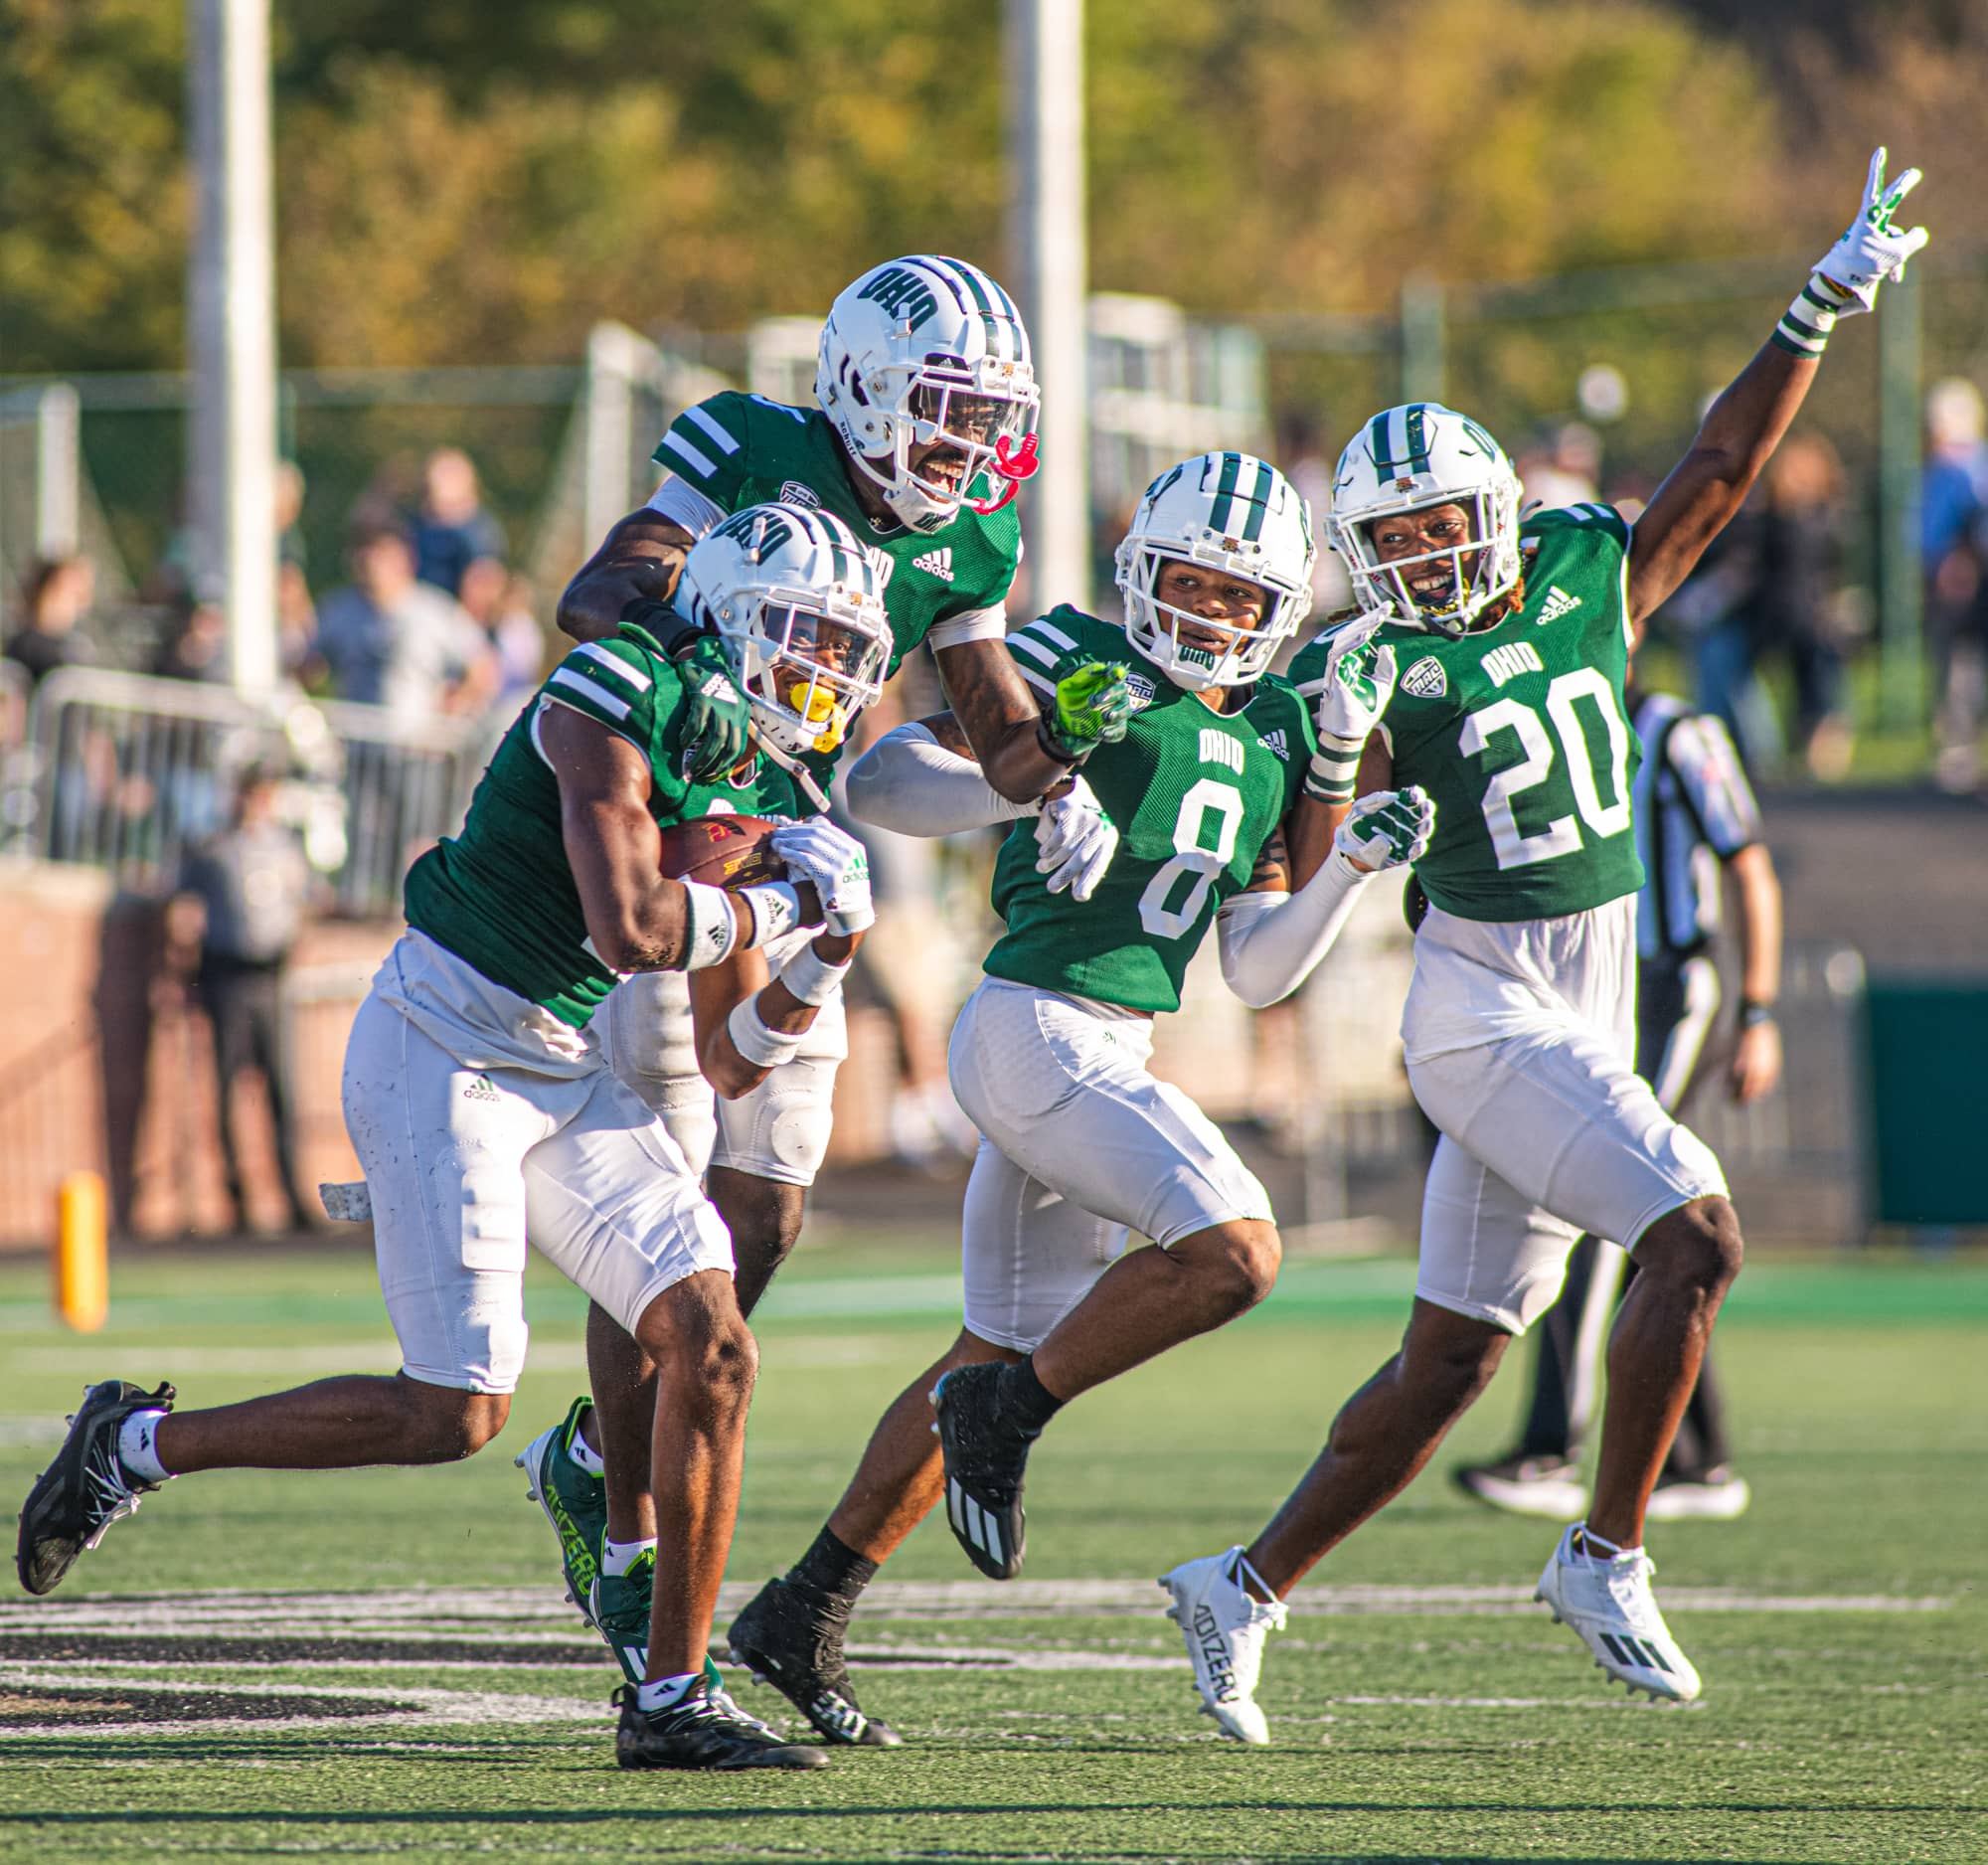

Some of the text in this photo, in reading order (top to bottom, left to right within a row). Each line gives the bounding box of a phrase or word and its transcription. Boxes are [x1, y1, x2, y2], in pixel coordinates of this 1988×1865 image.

[857, 267, 938, 334] OHIO
[912, 558, 954, 583] adidas
[1536, 596, 1582, 625] adidas
[1480, 641, 1544, 688] OHIO
[1198, 729, 1244, 775] OHIO
[1256, 738, 1290, 762] adidas
[1458, 666, 1631, 870] 20
[1138, 778, 1244, 940] 8
